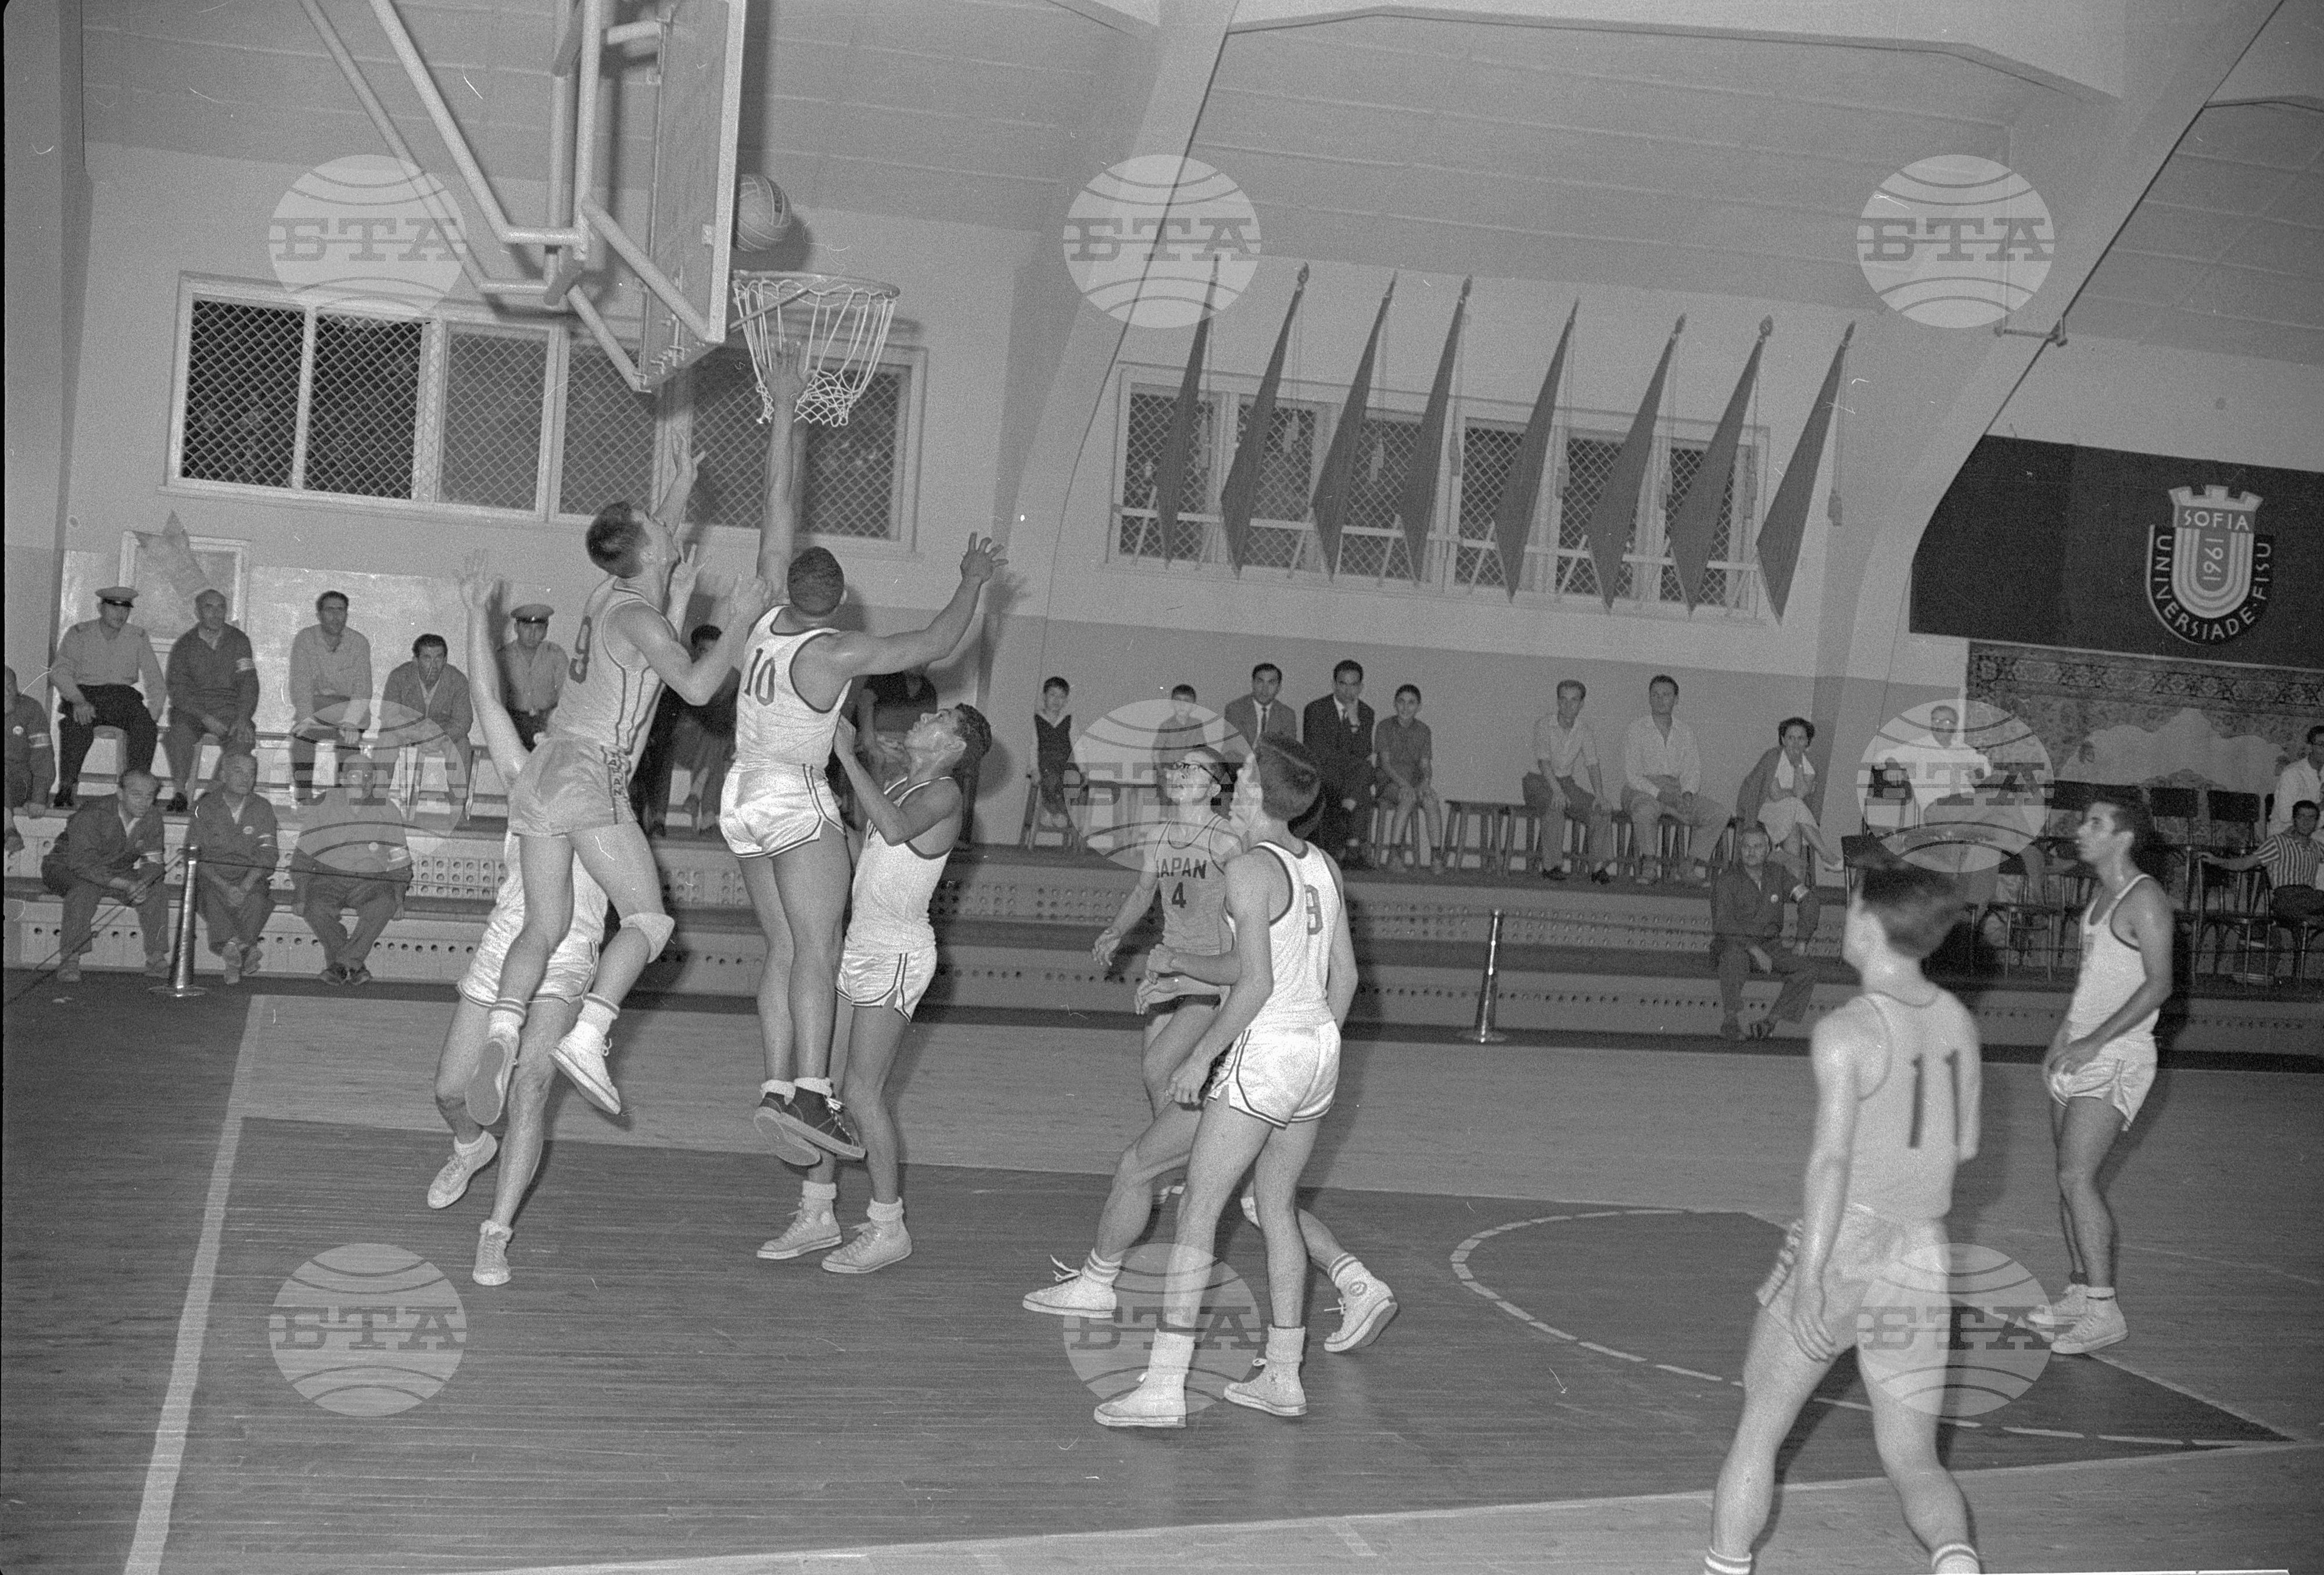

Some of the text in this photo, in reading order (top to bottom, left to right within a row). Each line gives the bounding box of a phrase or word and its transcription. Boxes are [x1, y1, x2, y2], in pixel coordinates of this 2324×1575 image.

[2184, 510, 2249, 531] SOFIA
[2203, 538, 2224, 581] 1961
[2154, 535, 2272, 640] UNIVERSIADE FISU
[744, 648, 776, 706] 10
[1172, 882, 1186, 908] 4
[1908, 1049, 1959, 1149] 11
